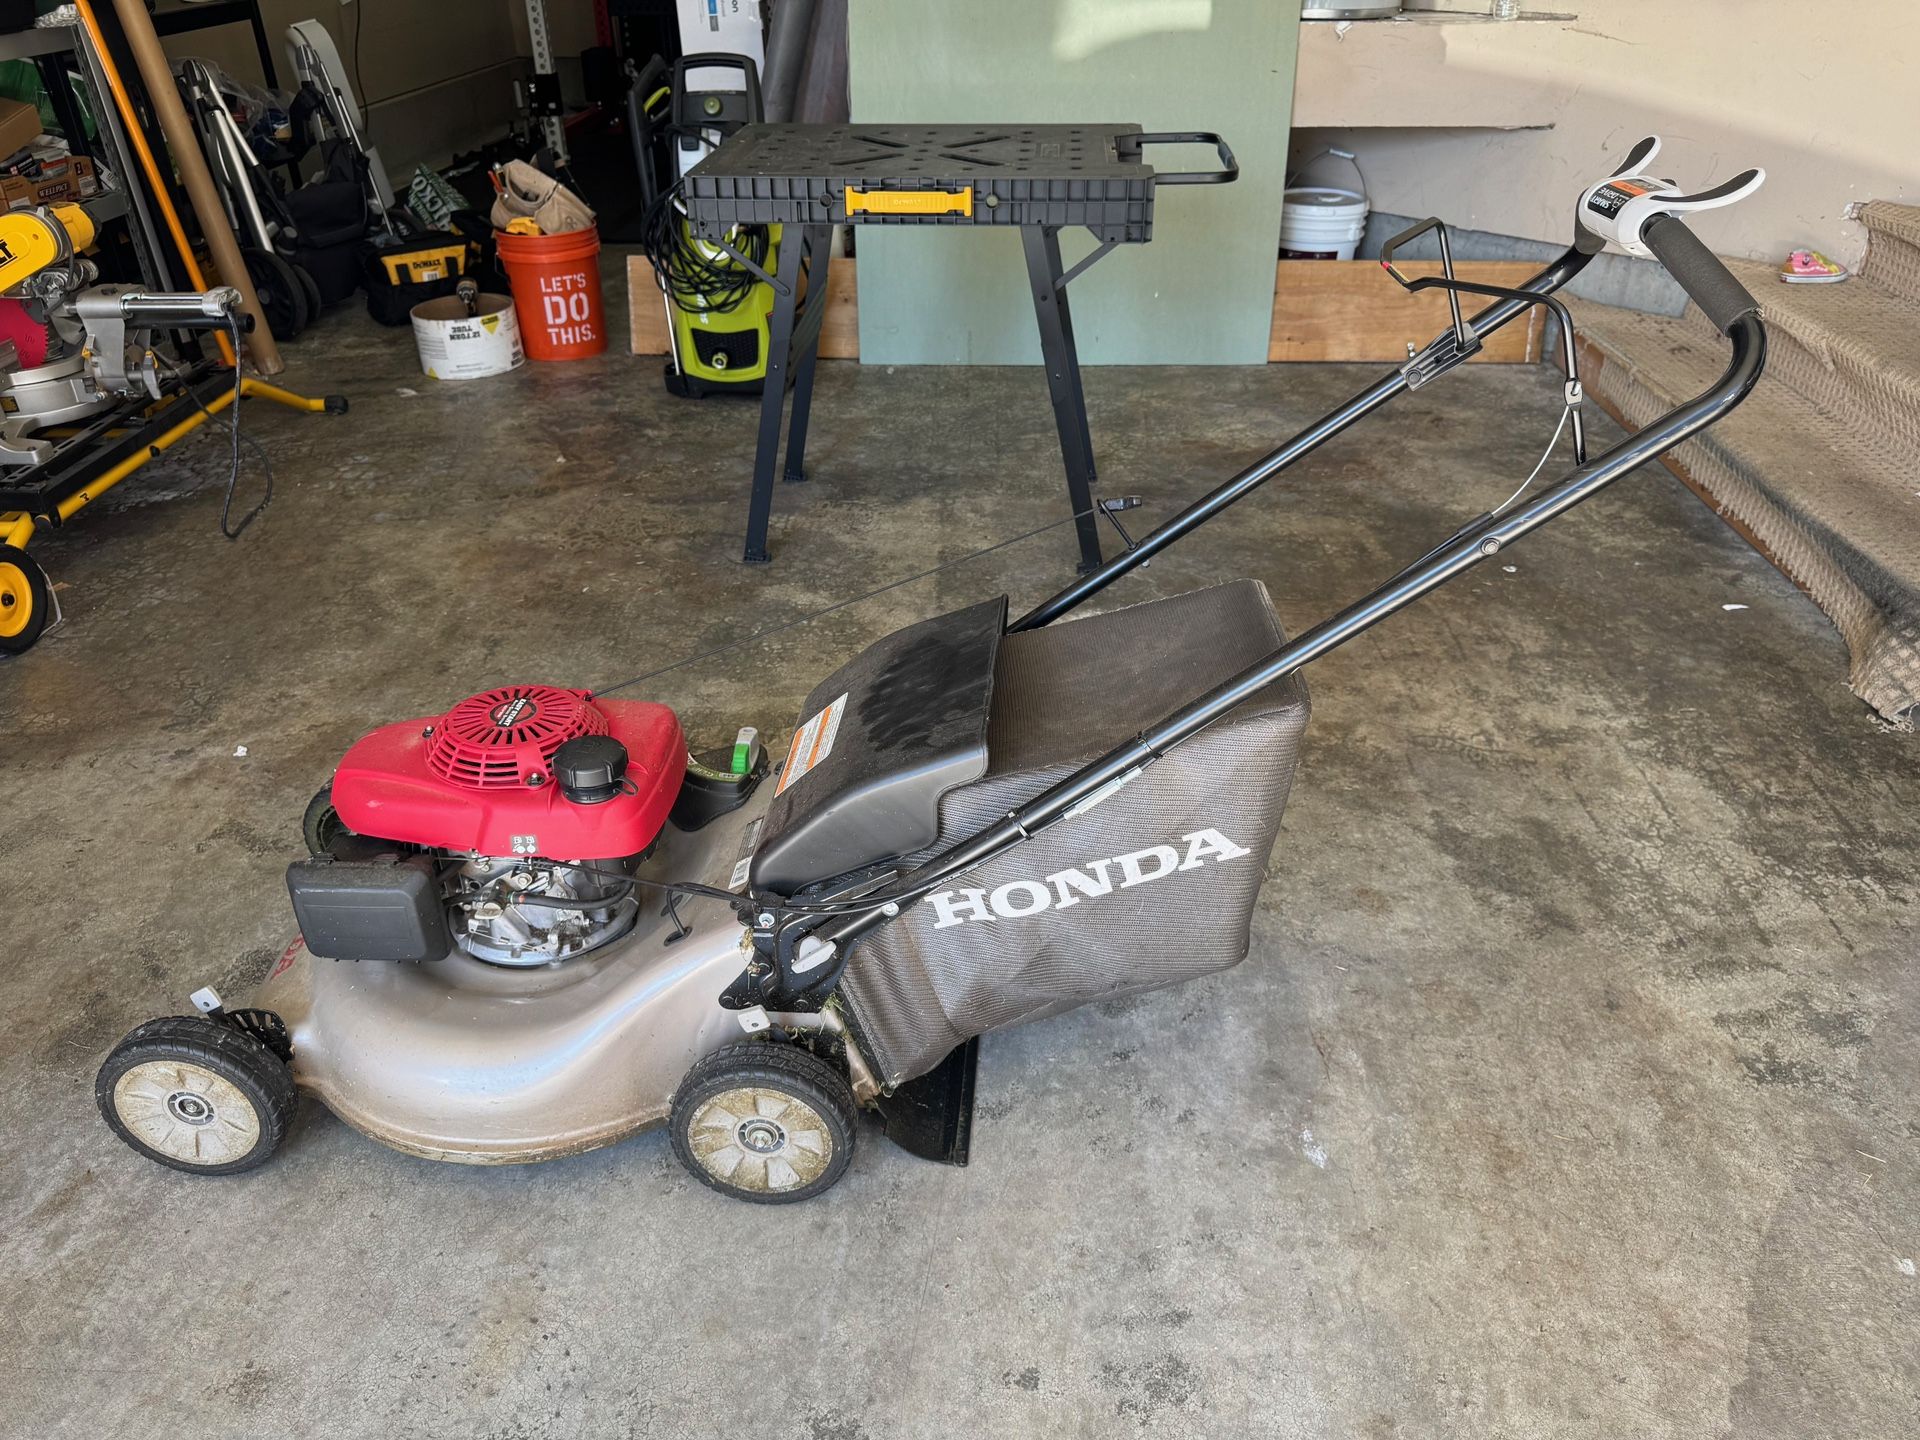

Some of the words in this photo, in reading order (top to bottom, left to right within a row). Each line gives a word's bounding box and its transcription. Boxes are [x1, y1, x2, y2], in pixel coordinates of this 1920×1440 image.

[540, 273, 587, 293] LET'S
[543, 292, 590, 325] DO
[547, 323, 597, 346] THIS.
[924, 828, 1251, 929] HONDA
